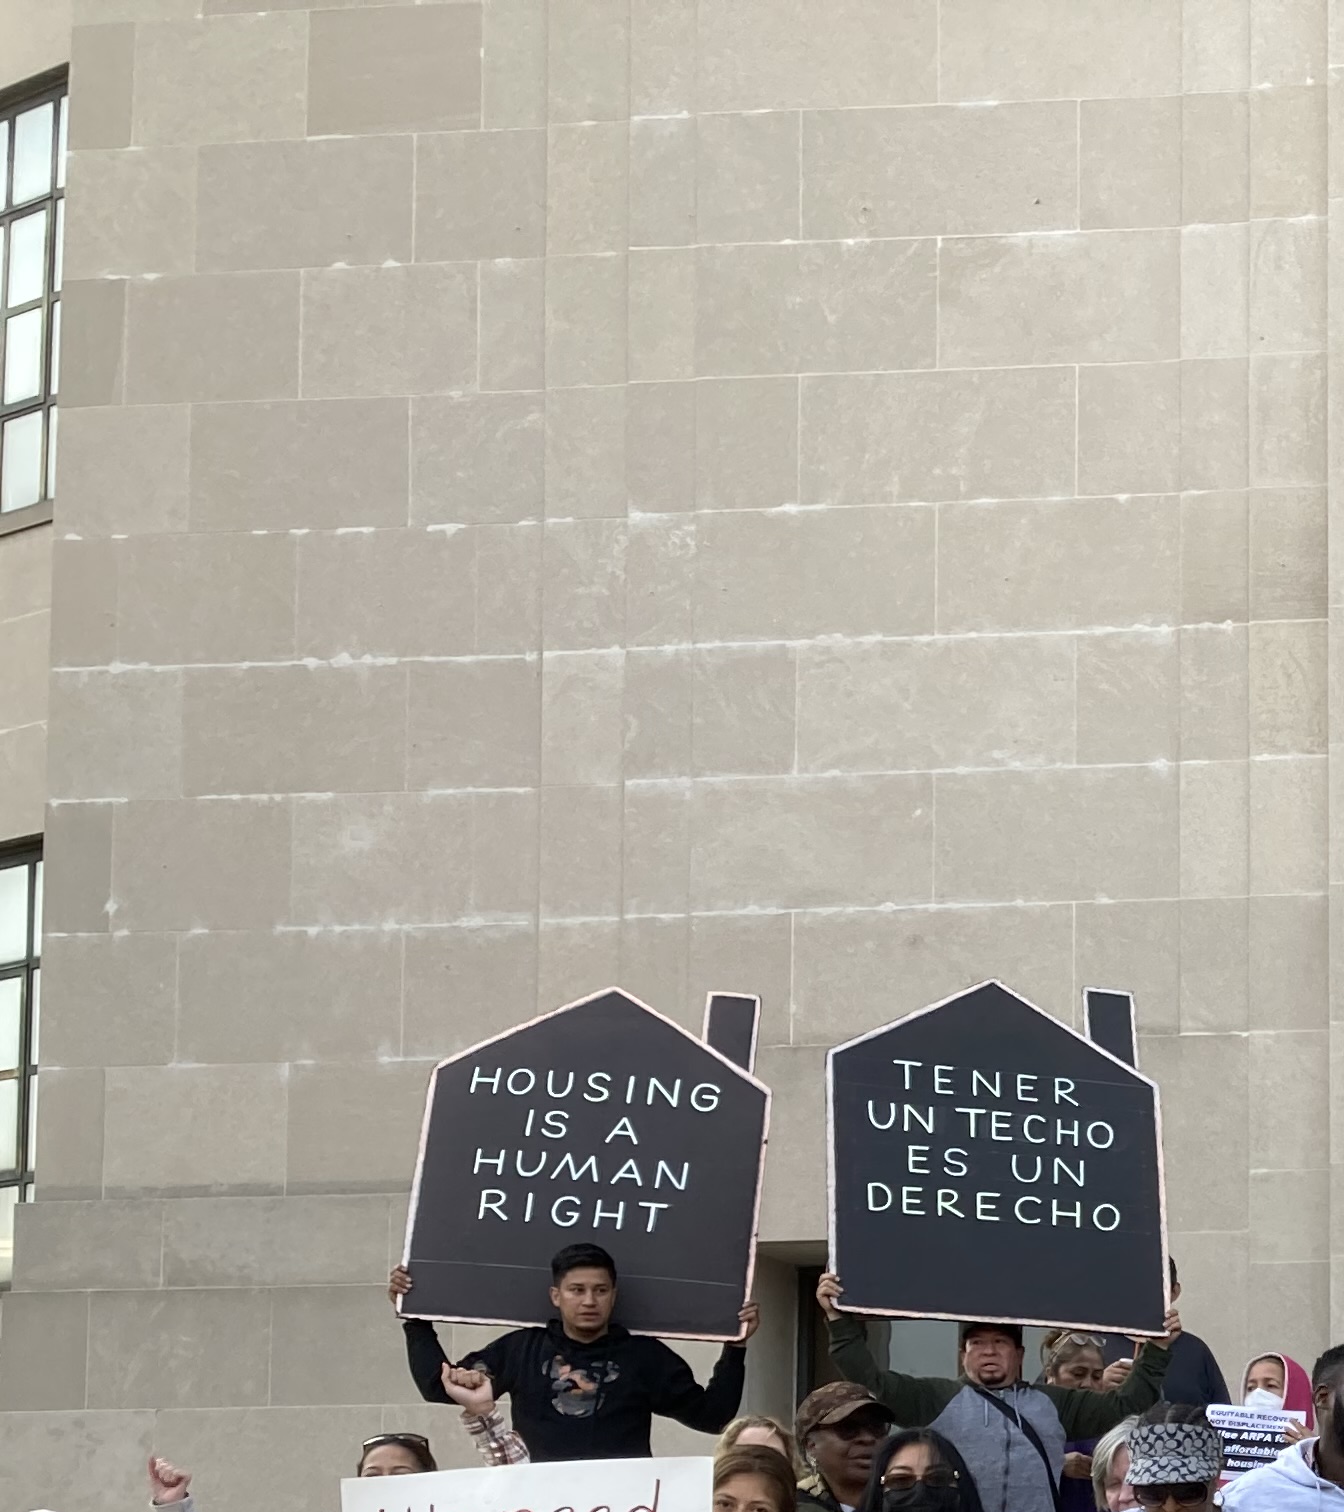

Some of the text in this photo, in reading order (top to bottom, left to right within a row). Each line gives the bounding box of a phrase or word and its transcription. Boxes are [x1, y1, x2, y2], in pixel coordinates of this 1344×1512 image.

[468, 1067, 721, 1112] HOUSING
[891, 1059, 1079, 1106] TENER
[523, 1109, 639, 1145] IS A
[867, 1101, 1115, 1150] UN TECHO
[473, 1148, 690, 1191] HUMAN
[907, 1146, 1086, 1187] ES UN
[477, 1190, 673, 1233] RIGHT
[865, 1183, 1122, 1232] DERECHO
[1211, 1410, 1255, 1419] EQUITABLE
[1240, 1432, 1271, 1442] ARPA
